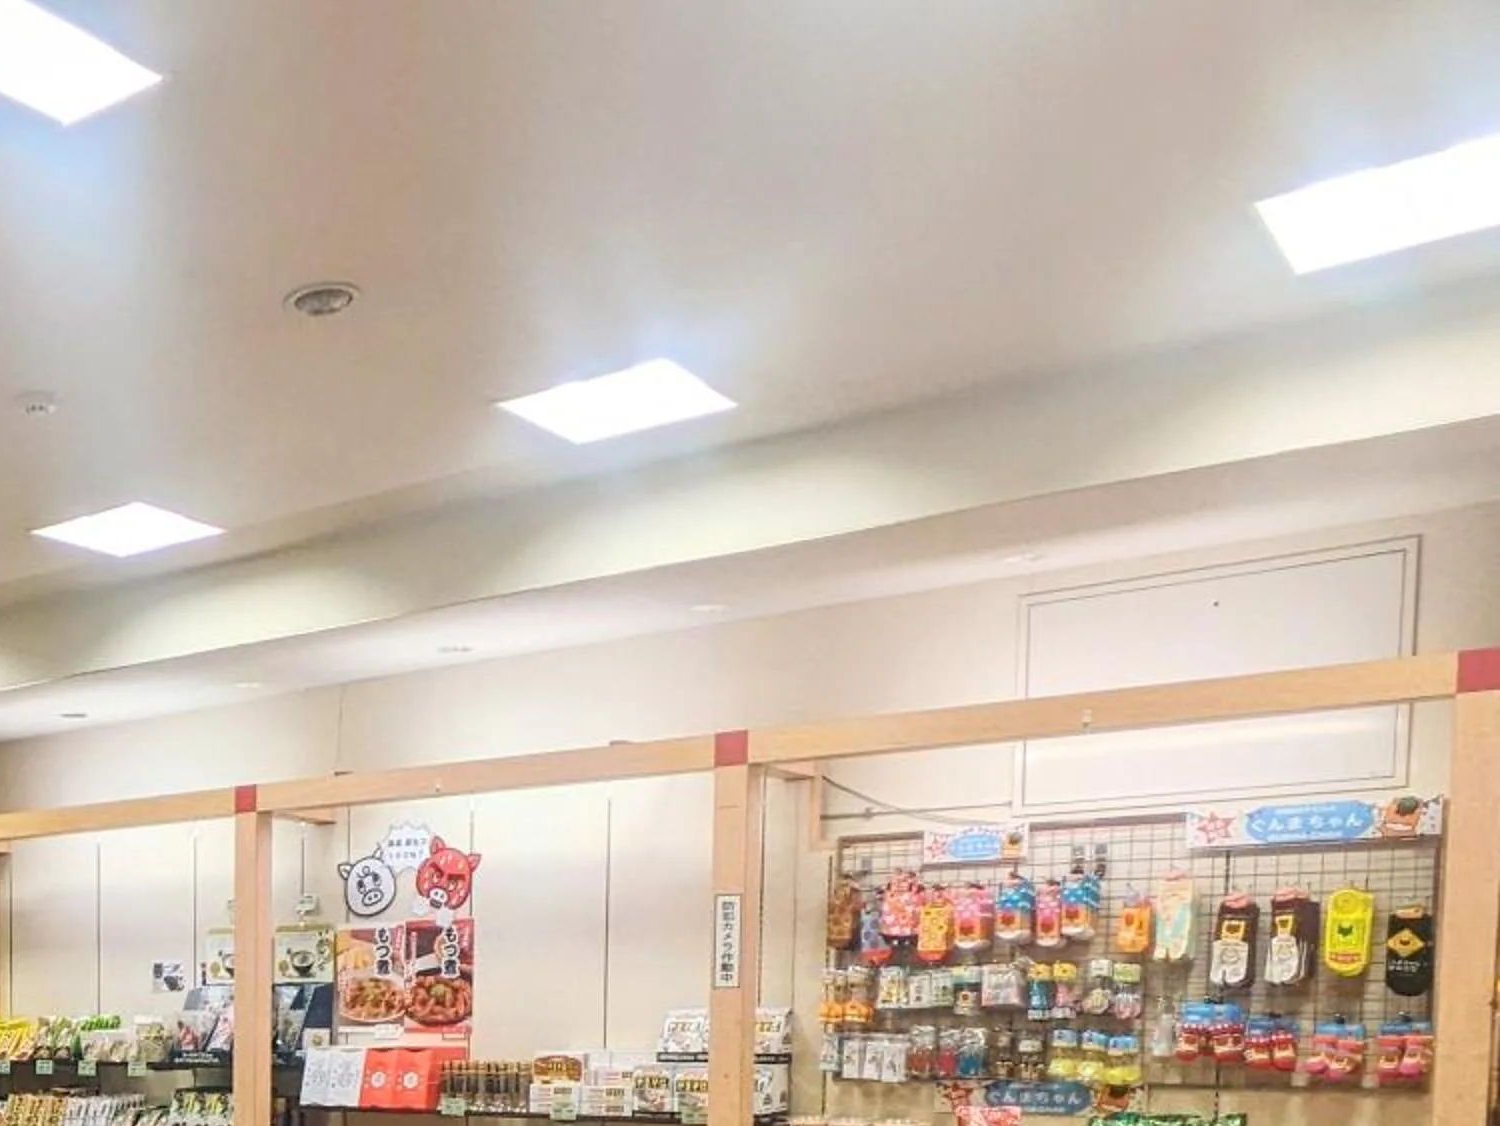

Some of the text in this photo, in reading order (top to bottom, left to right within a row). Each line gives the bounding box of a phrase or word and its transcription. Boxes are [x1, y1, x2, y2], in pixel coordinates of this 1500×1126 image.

[1252, 814, 1363, 831] ぐんまちゃん
